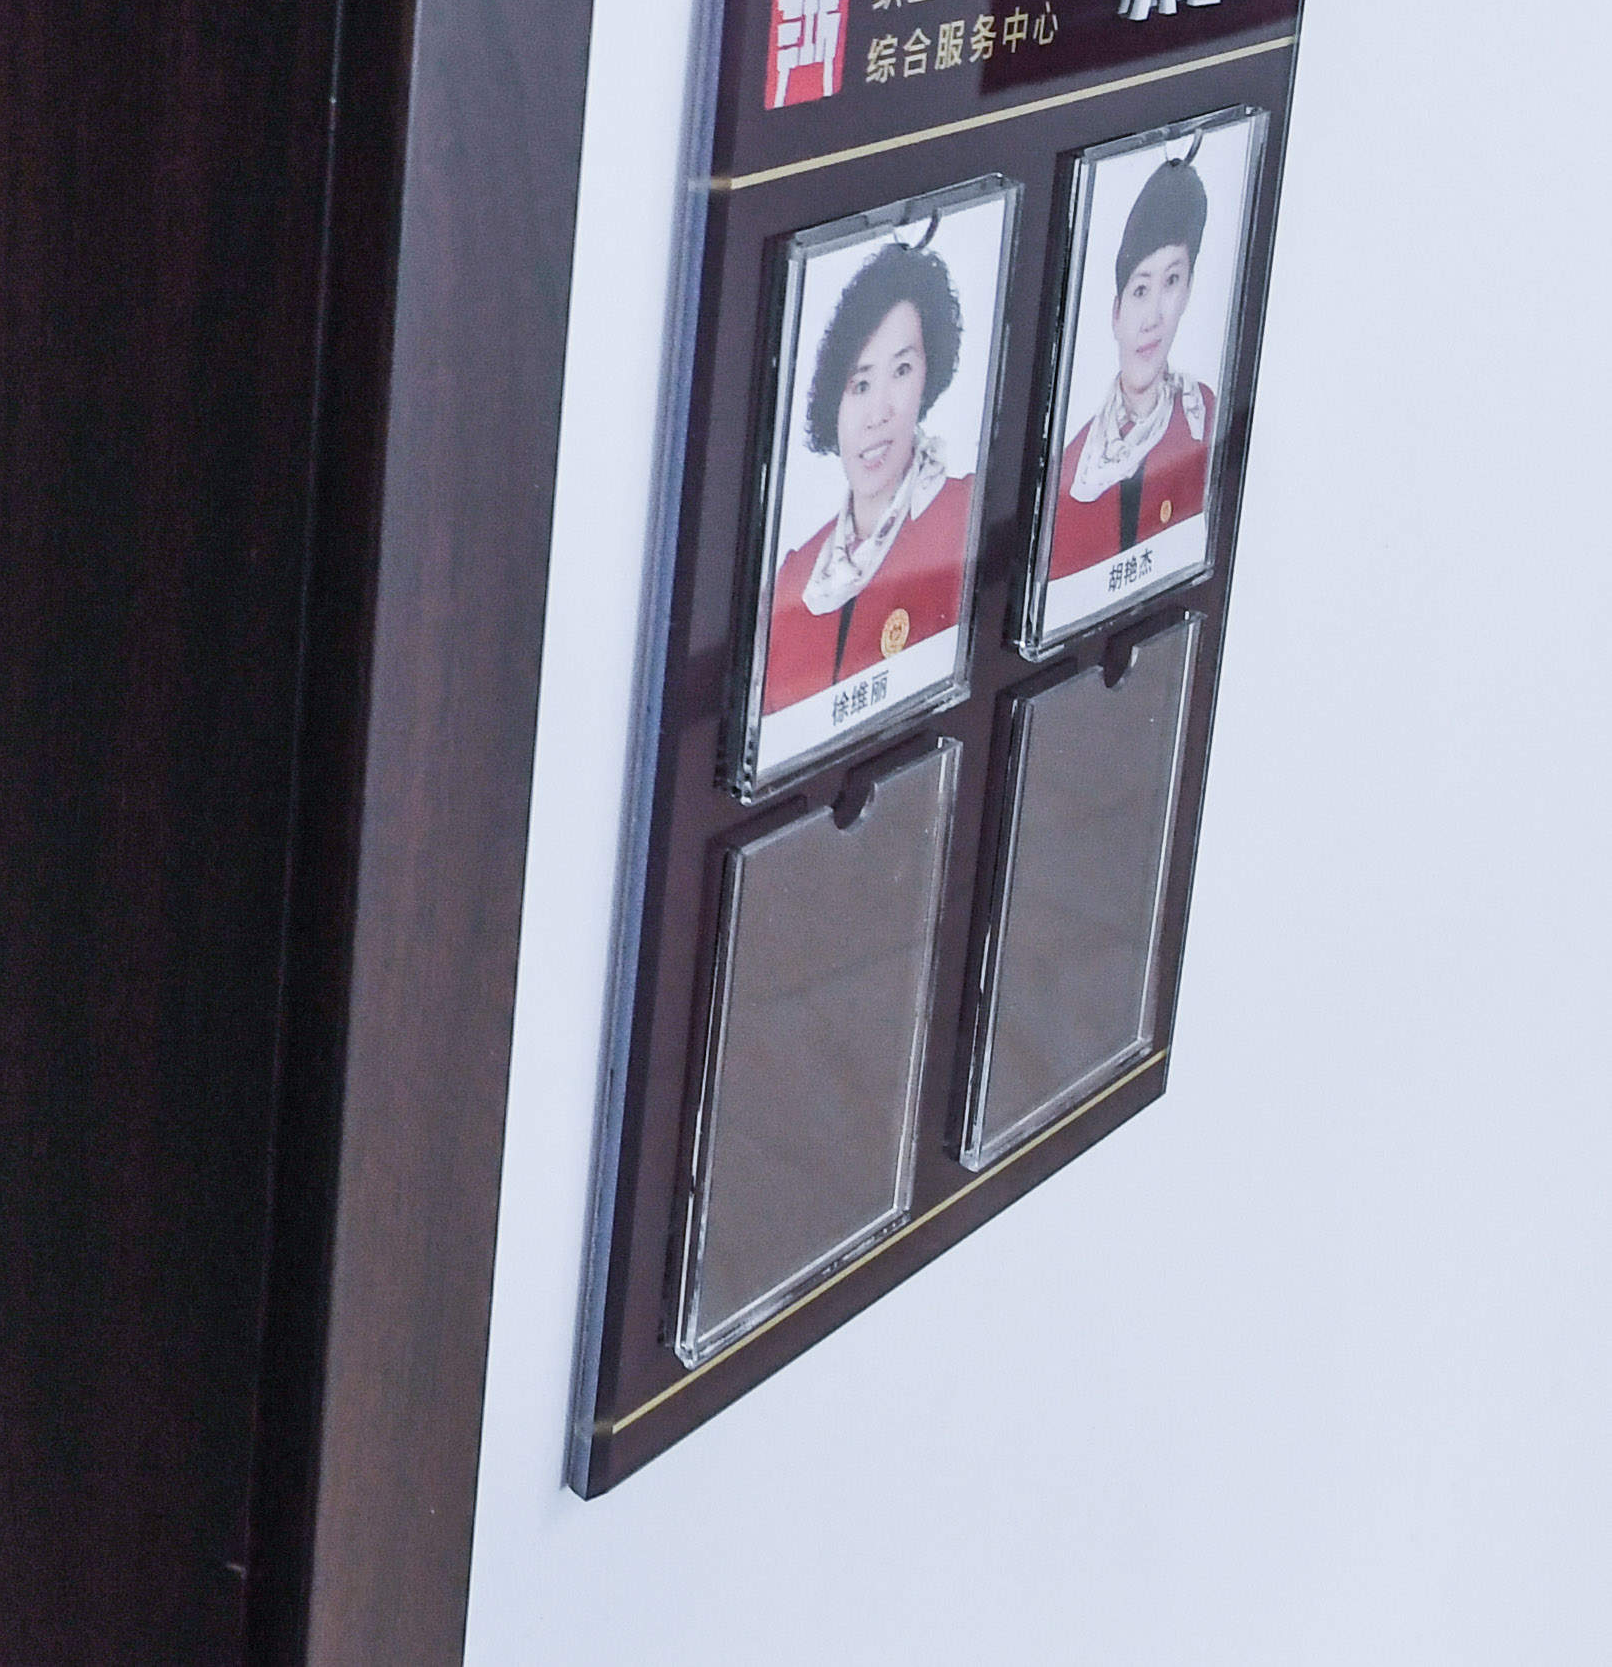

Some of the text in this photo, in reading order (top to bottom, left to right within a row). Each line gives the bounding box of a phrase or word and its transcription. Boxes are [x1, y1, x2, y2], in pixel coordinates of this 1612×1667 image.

[865, 0, 1060, 84] 综合服务中心
[1108, 547, 1153, 592] 胡艳杰
[832, 669, 889, 726] 徐维丽
